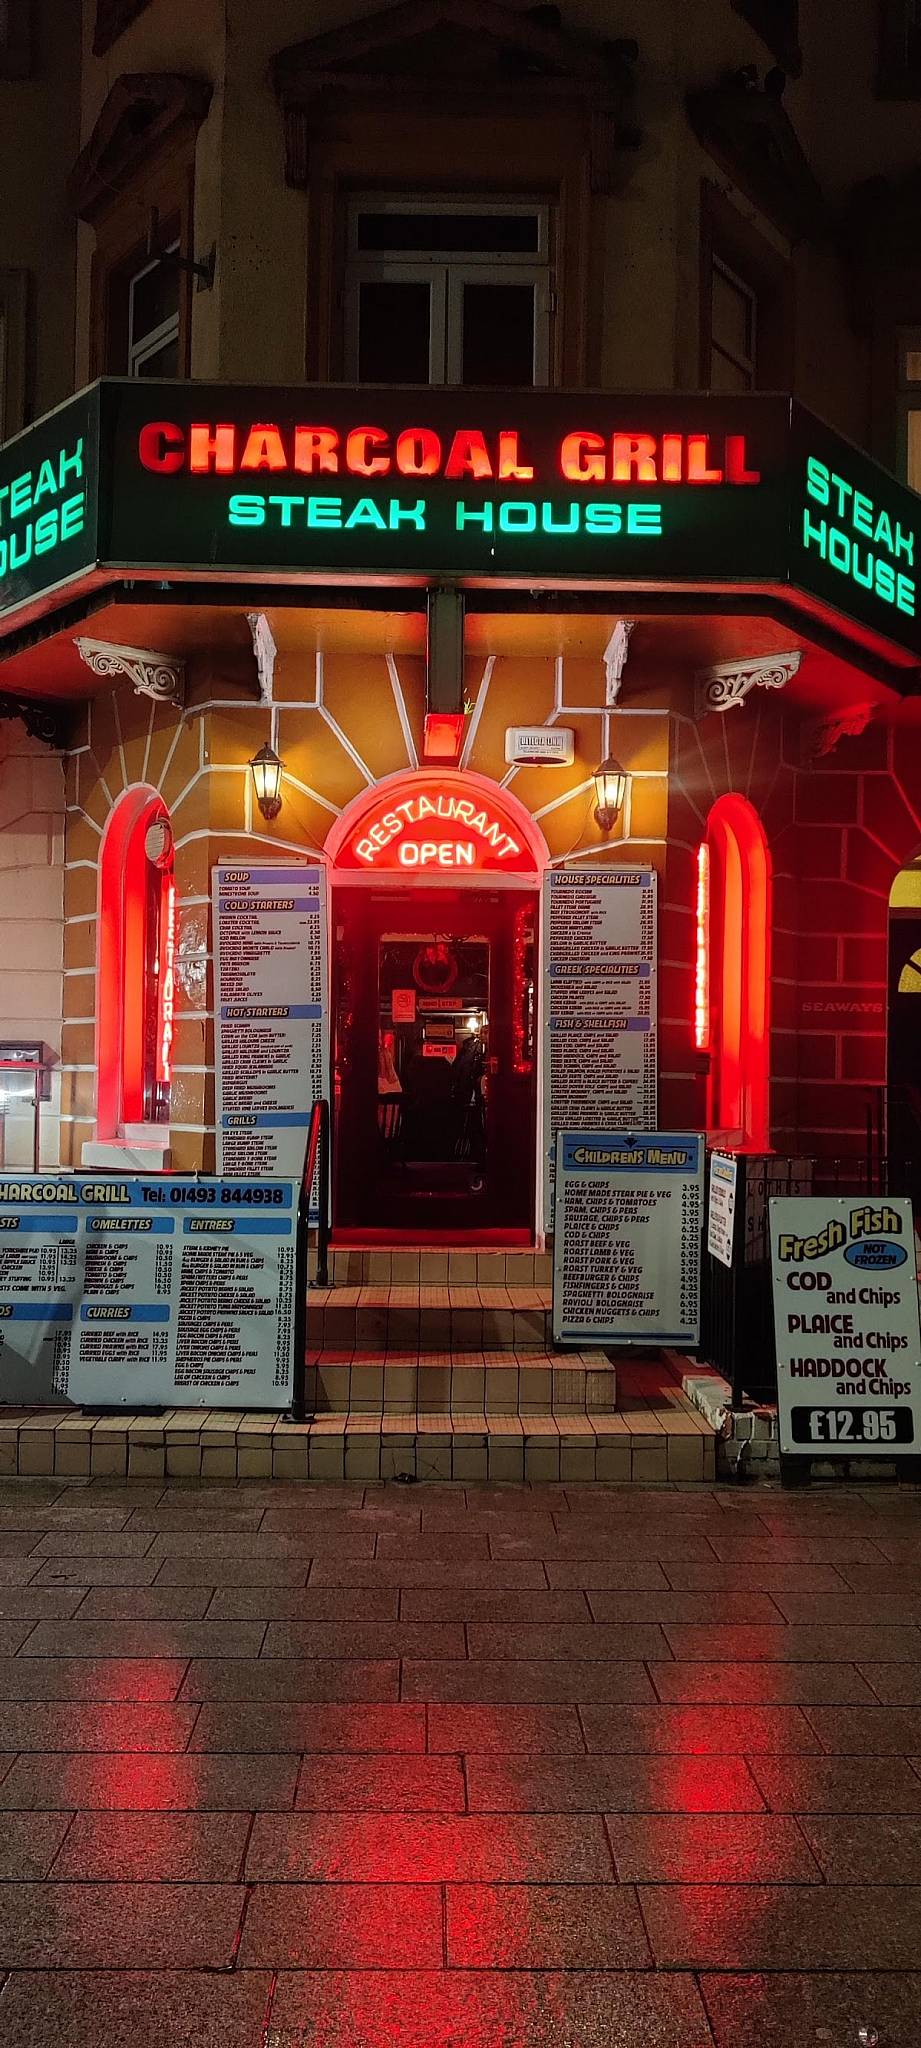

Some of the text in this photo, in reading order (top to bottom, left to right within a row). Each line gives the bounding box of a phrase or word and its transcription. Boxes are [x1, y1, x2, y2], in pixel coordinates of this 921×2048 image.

[139, 422, 761, 485] CHARCOAL GRILL
[228, 494, 662, 535] STEAK HOUSE
[807, 456, 914, 567] STEAK
[803, 508, 915, 617] HOUSE
[355, 795, 520, 862] RESTAURANT
[400, 843, 473, 865] OPEN
[224, 872, 250, 882] SOUP
[555, 875, 641, 885] HOUSE SPECIALITIES
[224, 900, 294, 911] COLD STARTERS
[555, 965, 639, 975] GREEK SPECIALITIES
[227, 1006, 288, 1017] HOT STARTERS
[555, 1019, 628, 1029] FISH & SHELLFISH
[227, 1115, 257, 1125] GRILLS
[574, 1147, 687, 1165] CHILDRENS MENU
[81, 1184, 131, 1203] GRILL
[141, 1187, 166, 1202] Tel:
[170, 1188, 216, 1203] 01493
[220, 1188, 283, 1204] 844938
[91, 1218, 152, 1230] OMELETTES
[190, 1219, 234, 1231] ENTREES
[779, 1220, 846, 1261] Fresh
[850, 1206, 902, 1239] Fish
[863, 1243, 887, 1254] NOT
[855, 1255, 897, 1265] FROZEN
[787, 1271, 832, 1291] COD
[827, 1287, 901, 1308] and Chips
[86, 1307, 131, 1318] CURRIES
[788, 1314, 854, 1333] PLAICE
[833, 1331, 908, 1352] and Chips
[790, 1358, 888, 1378] HADDOCK
[836, 1378, 912, 1399] and Chips
[809, 1410, 897, 1440] £12.95
